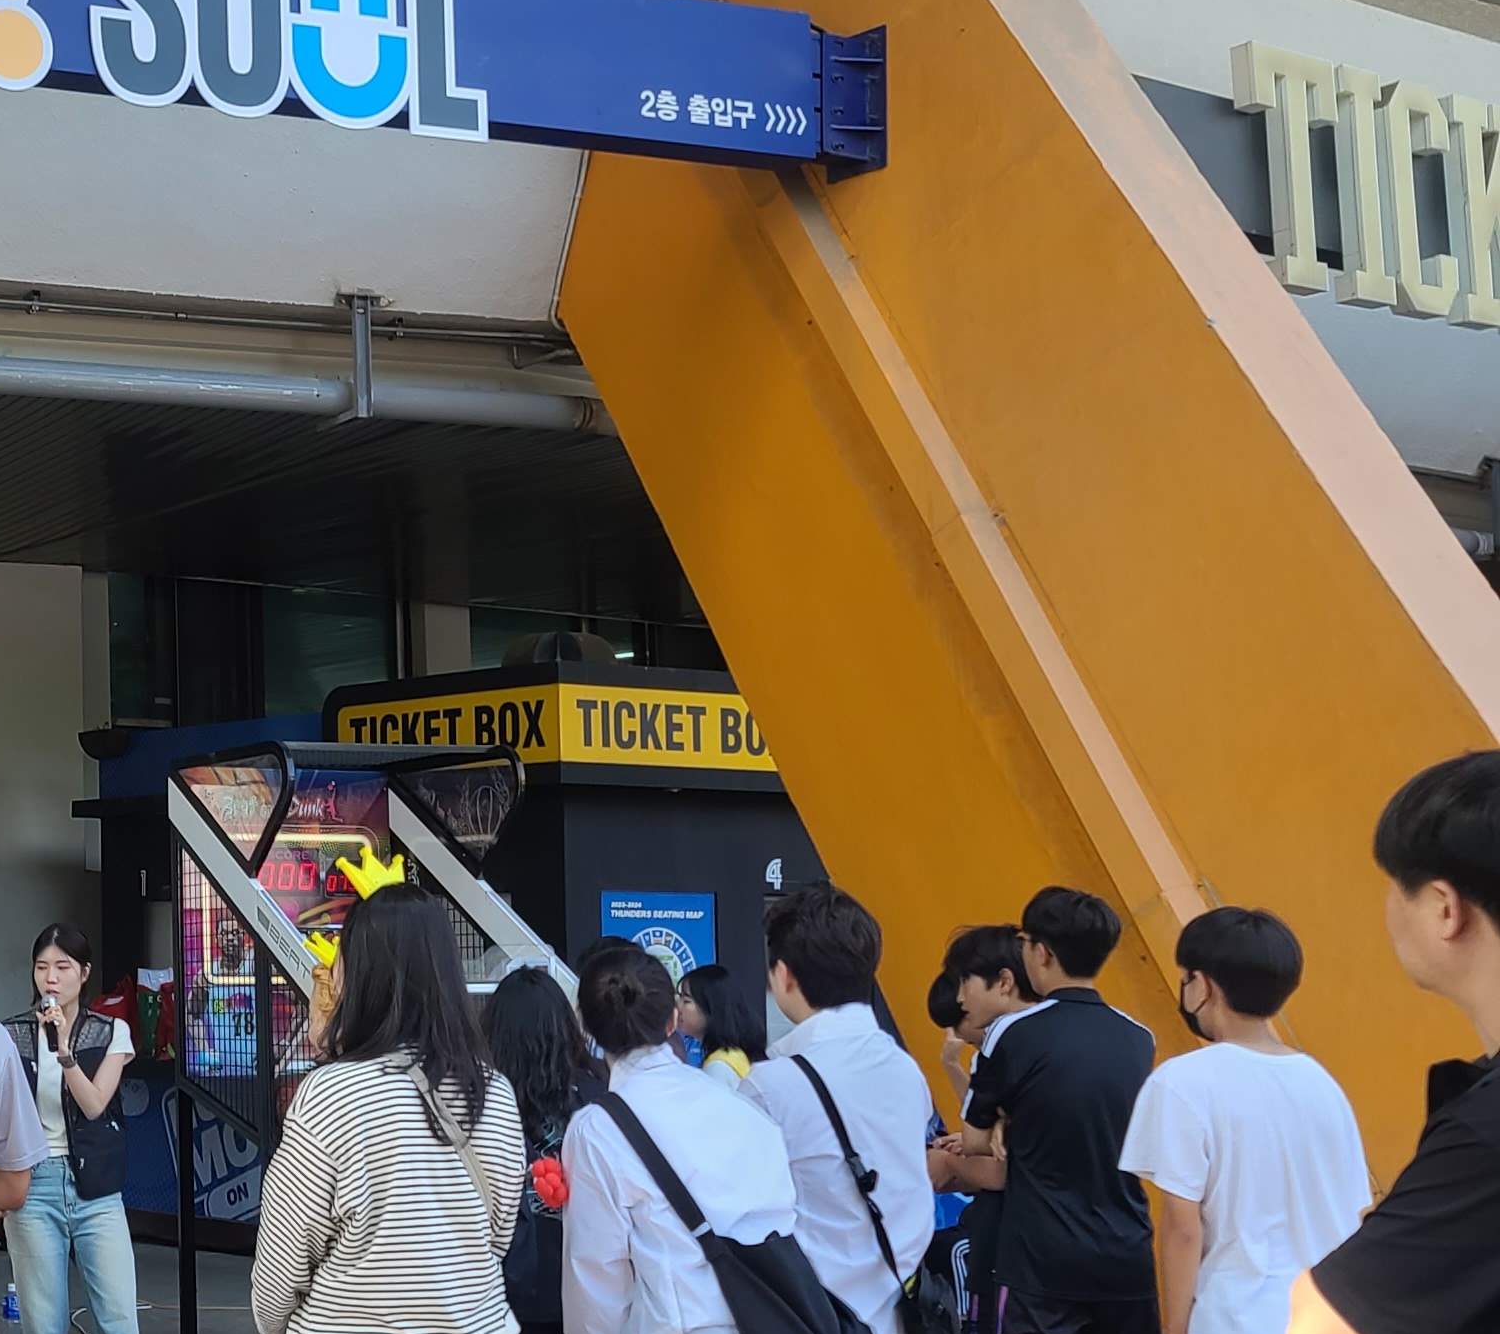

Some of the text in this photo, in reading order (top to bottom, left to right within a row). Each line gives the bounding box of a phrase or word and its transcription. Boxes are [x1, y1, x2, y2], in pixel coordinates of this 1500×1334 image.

[640, 89, 757, 130] 2층 출입구
[475, 699, 546, 749] BOX
[576, 698, 772, 757] TICKET BO
[765, 857, 783, 891] 4
[610, 909, 705, 920] THUNDERS SEATING MAP
[226, 1182, 249, 1206] ON
